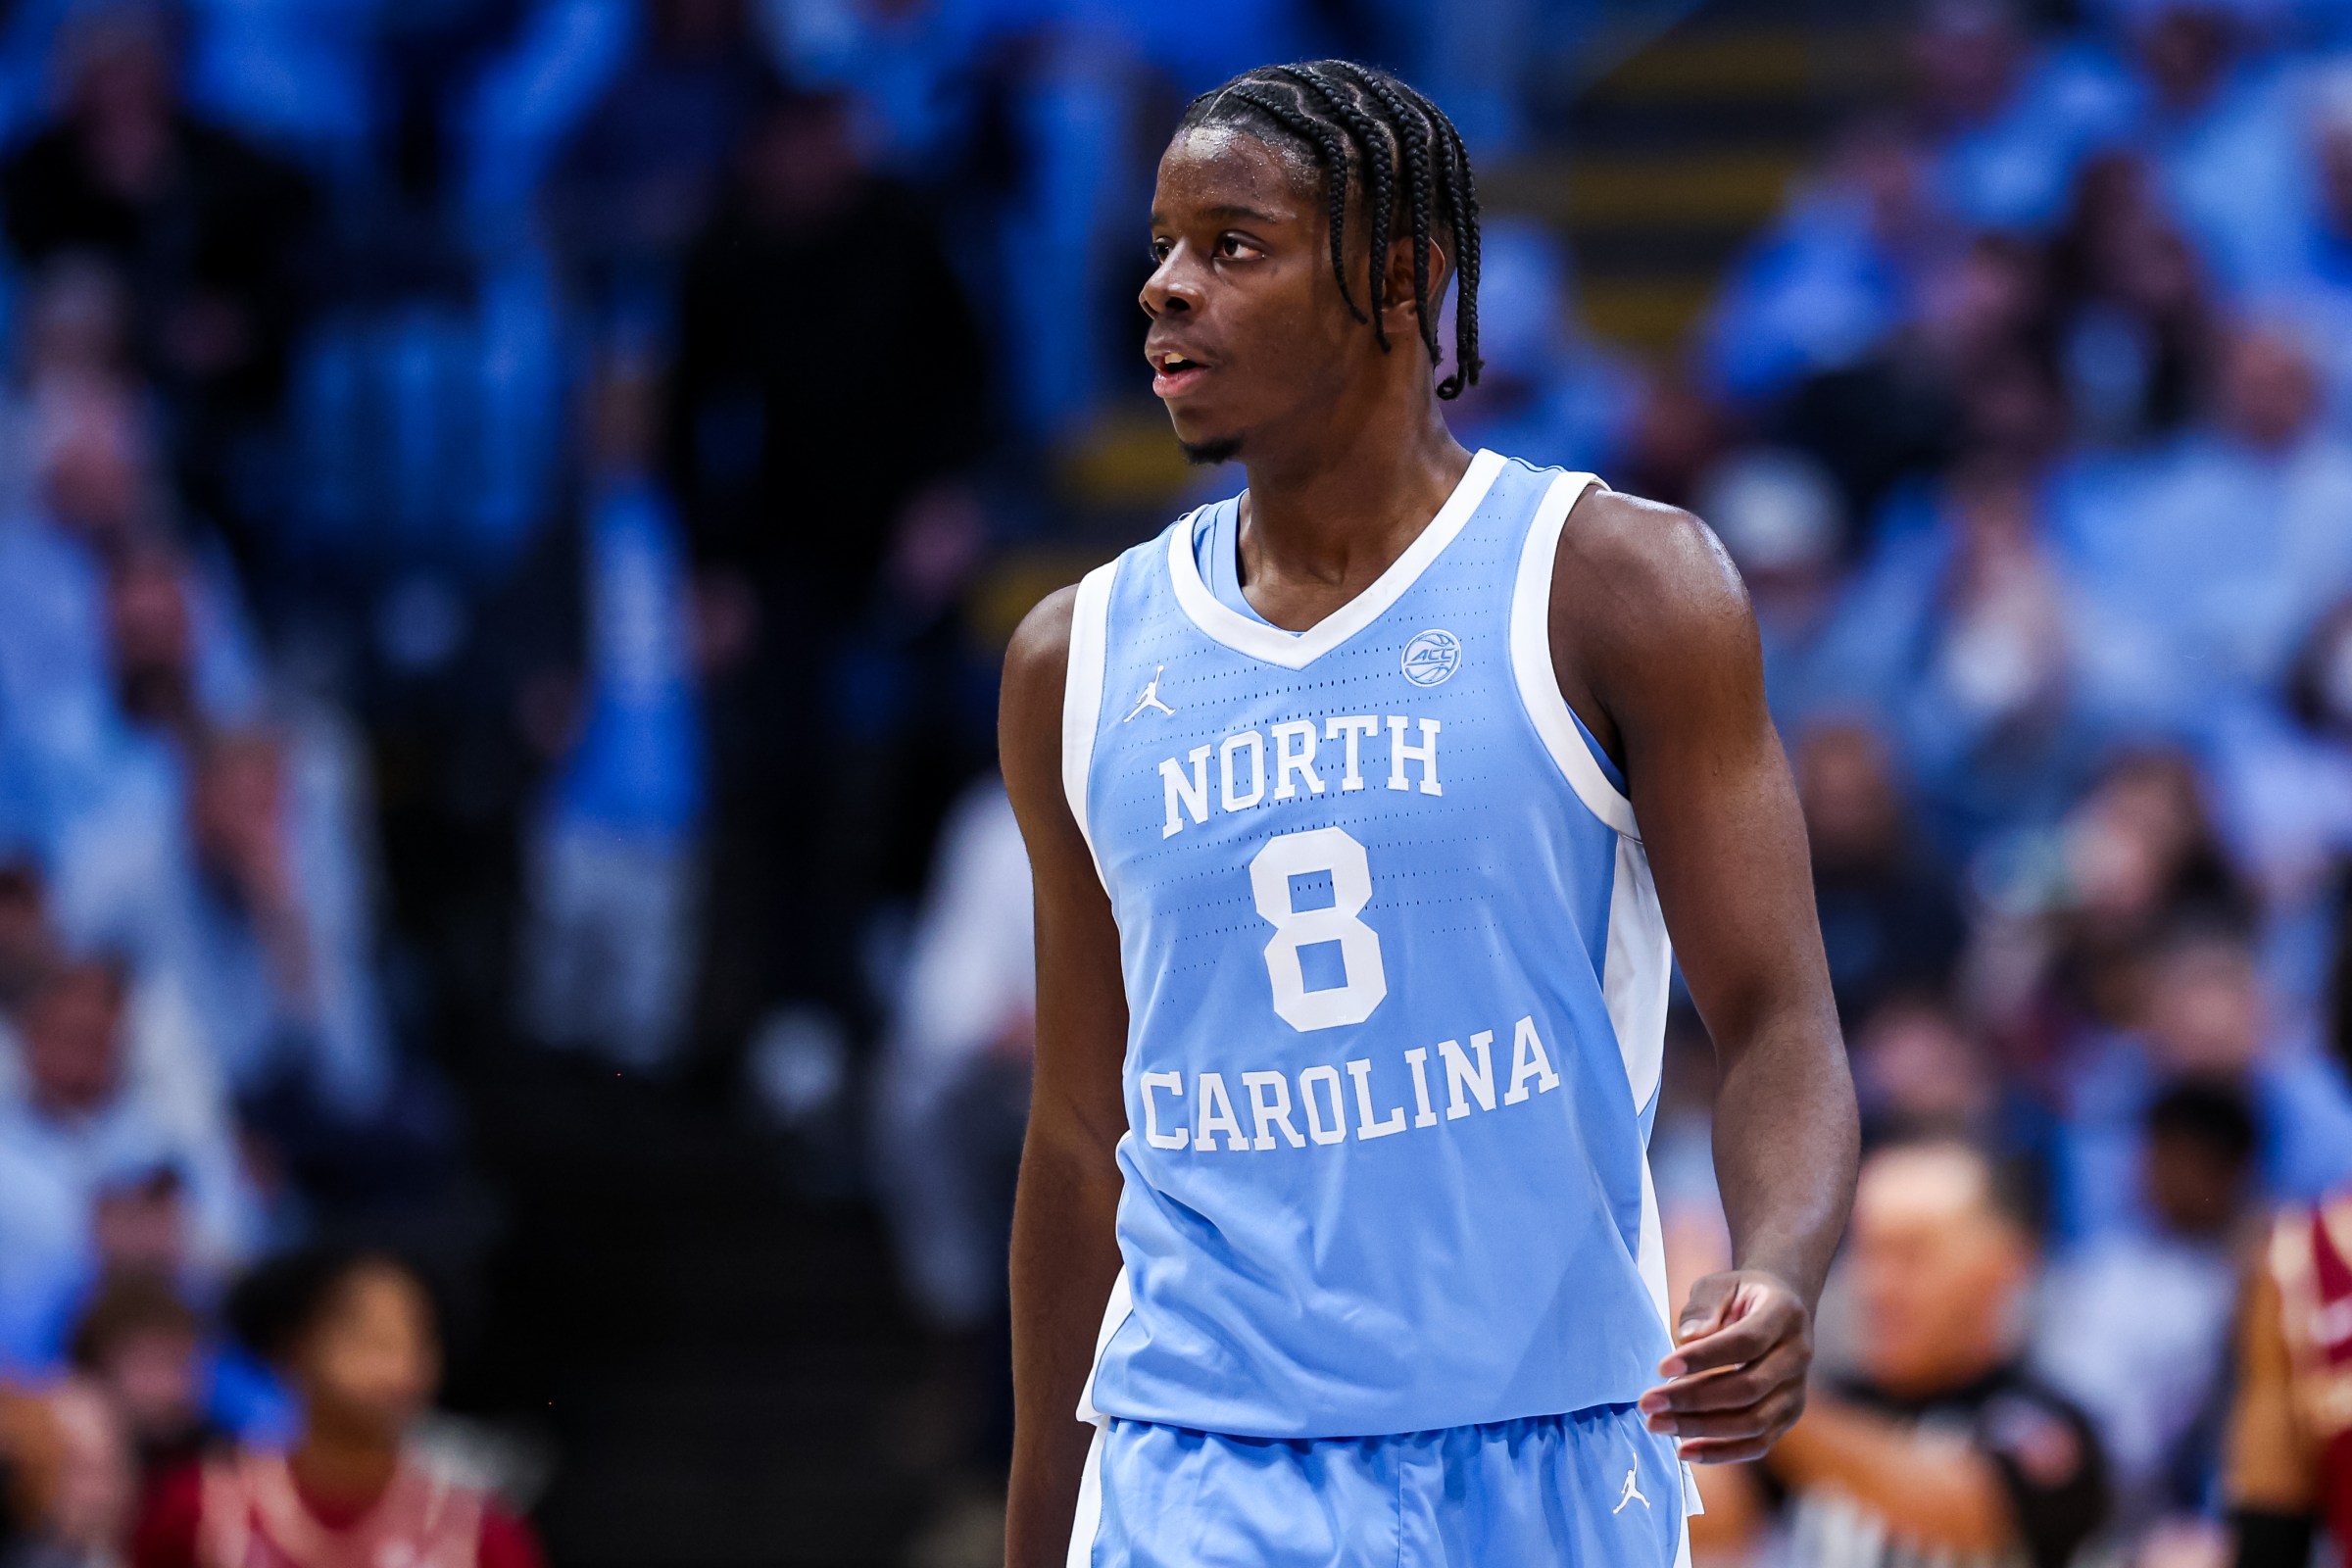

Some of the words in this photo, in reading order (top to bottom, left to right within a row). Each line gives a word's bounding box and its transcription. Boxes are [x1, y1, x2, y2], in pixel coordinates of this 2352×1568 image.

[1411, 648, 1455, 662] ACC
[1158, 714, 1443, 840] NORTH
[1250, 826, 1387, 1032] 8
[1140, 1015, 1559, 1152] CAROLINA
